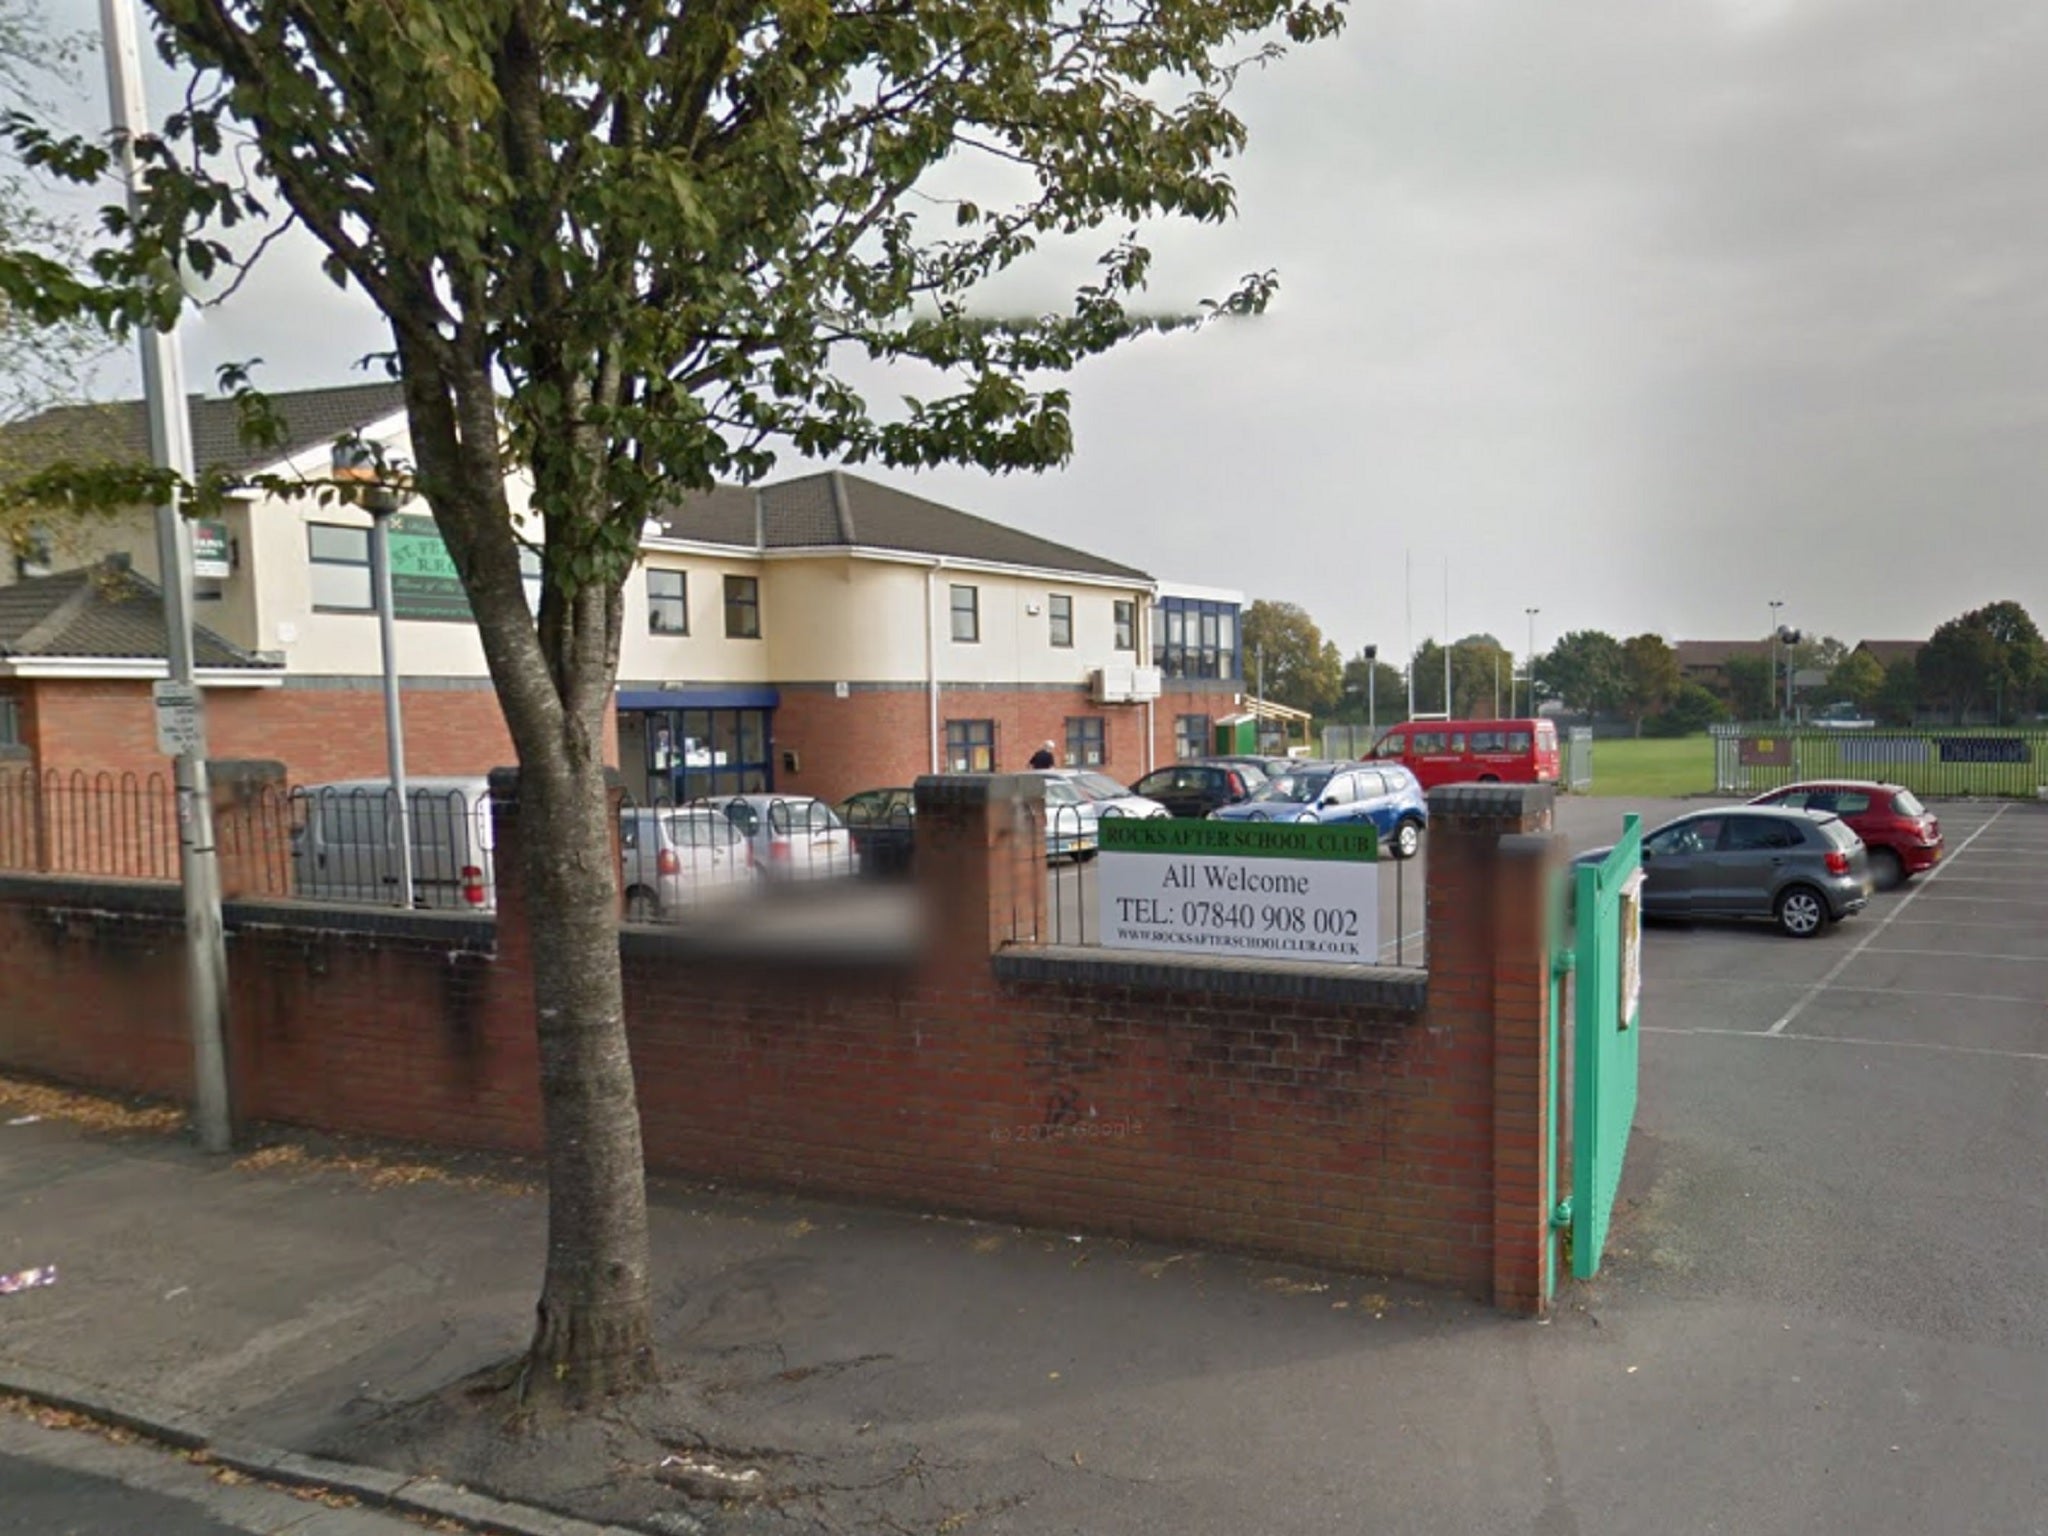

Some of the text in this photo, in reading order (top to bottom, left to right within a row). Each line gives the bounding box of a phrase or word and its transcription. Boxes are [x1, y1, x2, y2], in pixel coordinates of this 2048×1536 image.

[1106, 826, 1370, 852] ROCKS AFTER SCHOOL CLUB
[1161, 864, 1310, 895] All Welcome
[1116, 897, 1359, 937] TEL: 07840 908 002
